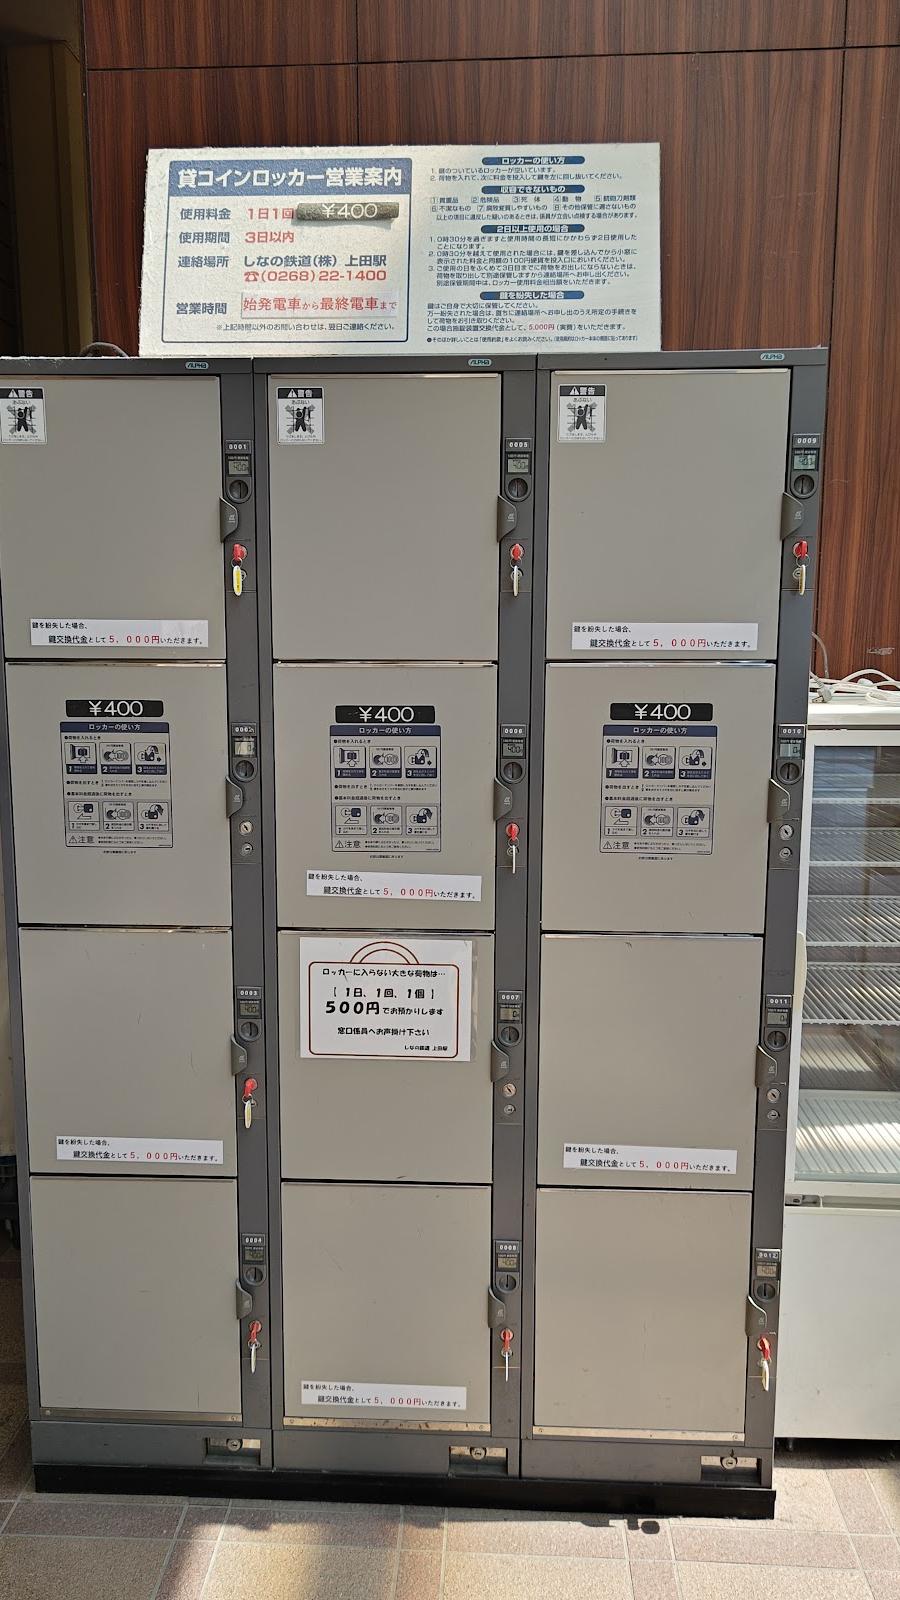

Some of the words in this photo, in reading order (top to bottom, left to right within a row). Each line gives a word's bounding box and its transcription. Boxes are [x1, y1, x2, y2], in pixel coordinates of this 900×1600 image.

[502, 156, 565, 165] ロッカーの使い方
[177, 167, 402, 188] 貸コインロッカー営業案内
[180, 207, 231, 220] 使用料金
[322, 203, 378, 219] ¥400
[497, 225, 569, 233] 2日以上使用の場合
[179, 232, 230, 244] 使用期間
[245, 231, 295, 243] 3日以内
[177, 256, 230, 268] 連絡場所
[345, 255, 387, 267] 上田駅
[176, 303, 227, 315] 営業時間
[243, 297, 397, 312] 始発電車から最終電車まで
[89, 701, 143, 716] ¥400
[359, 706, 414, 723] ¥400
[634, 703, 692, 720] ¥400
[634, 727, 688, 735] ロッカーの使い方
